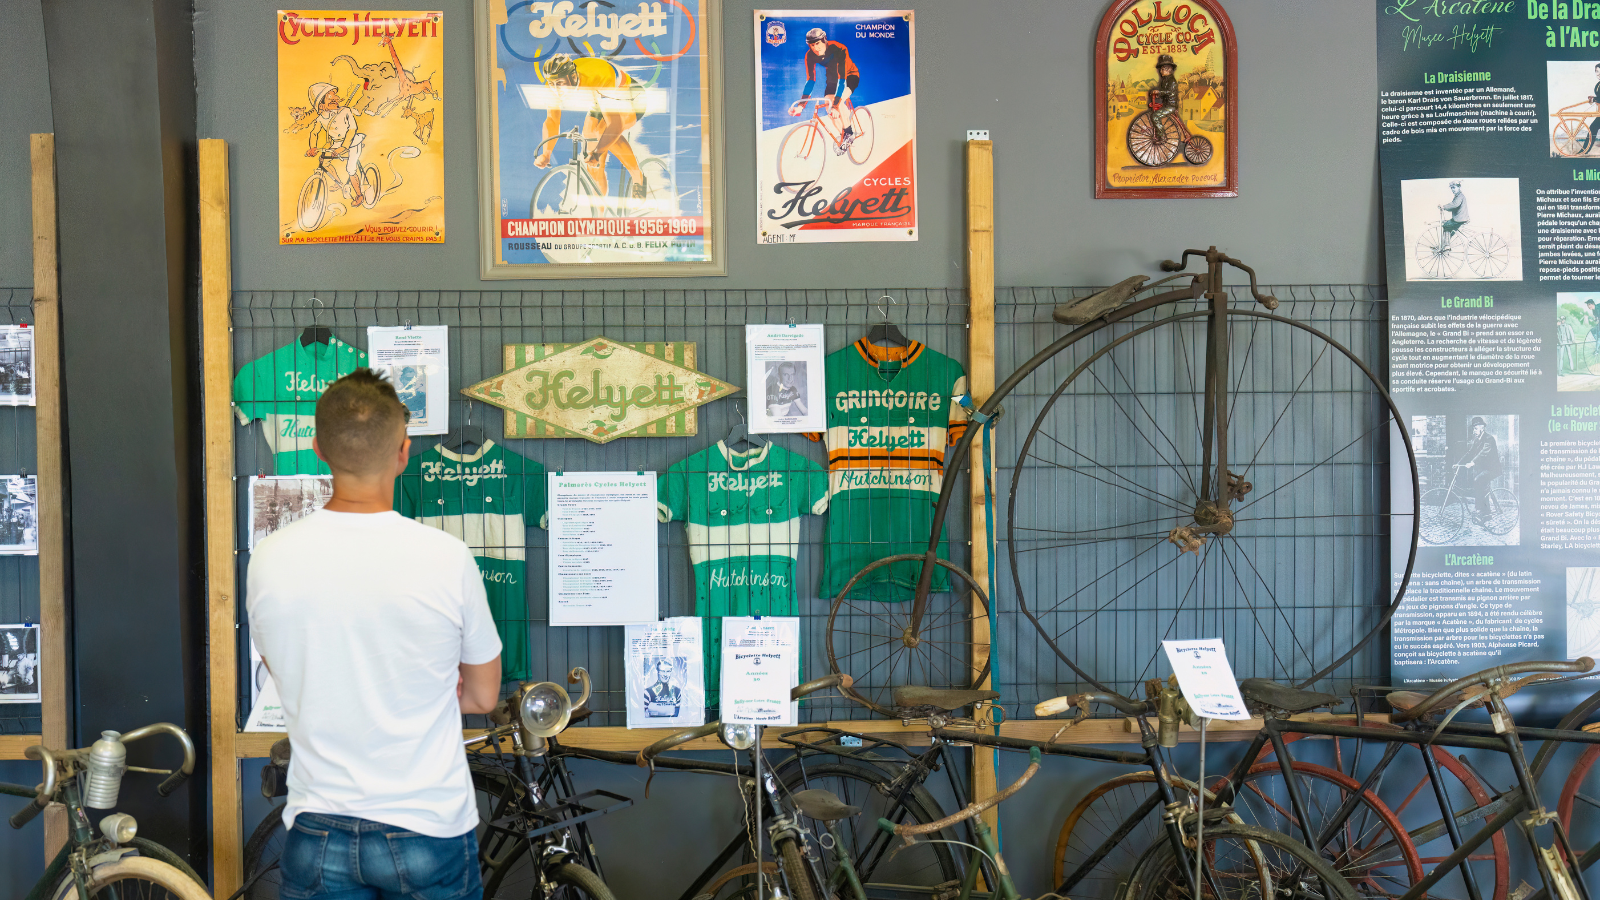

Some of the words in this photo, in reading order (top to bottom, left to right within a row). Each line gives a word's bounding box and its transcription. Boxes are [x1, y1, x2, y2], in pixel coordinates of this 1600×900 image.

[1528, 0, 1548, 19] De
[1553, 0, 1568, 19] la
[1573, 0, 1600, 19] Dra
[279, 12, 348, 45] CYCLES
[352, 12, 442, 45] HELYETT
[529, 0, 667, 50] Helyett
[1114, 1, 1216, 62] POLLOCK
[1137, 32, 1172, 45] CYCLE
[1176, 31, 1194, 44] CO.
[1446, 24, 1502, 53] Helyett
[1546, 26, 1556, 47] à
[1560, 26, 1599, 47] l'Arc
[1142, 44, 1187, 54] EST-1883
[1424, 72, 1436, 83] La
[1438, 70, 1492, 83] Draisienne
[1485, 86, 1516, 94] Allemand,
[1502, 94, 1519, 103] juillet
[1401, 112, 1419, 121] grâce
[1480, 110, 1508, 119] (machine
[1514, 110, 1537, 118] courir).
[1405, 104, 1434, 113] parcourt
[1382, 136, 1402, 144] pieds.
[863, 177, 911, 186] CYCLES
[1573, 169, 1584, 180] La
[767, 180, 912, 227] Helyett
[363, 224, 382, 232] VOUS
[507, 221, 564, 236] CHAMPION
[568, 220, 630, 236] OLYMPIQUE
[634, 218, 697, 234] 1956-1960
[508, 242, 552, 250] ROUSSEAU
[1442, 296, 1452, 308] Le
[1454, 296, 1482, 308] Grand
[1485, 296, 1493, 307] Bi
[1478, 313, 1522, 321] vélocipédique
[1391, 322, 1420, 330] française
[525, 369, 686, 422] Helyett
[1551, 405, 1562, 416] La
[1548, 419, 1561, 433] (le
[1570, 420, 1598, 432] Rover
[848, 428, 925, 452] Helyett
[422, 459, 507, 486] Helyett
[839, 466, 933, 488] Hutchinson
[708, 472, 783, 497] Helyett
[1445, 552, 1494, 566] L'Arcatène
[710, 567, 789, 590] Hutchinson
[1394, 658, 1423, 667] baptisera
